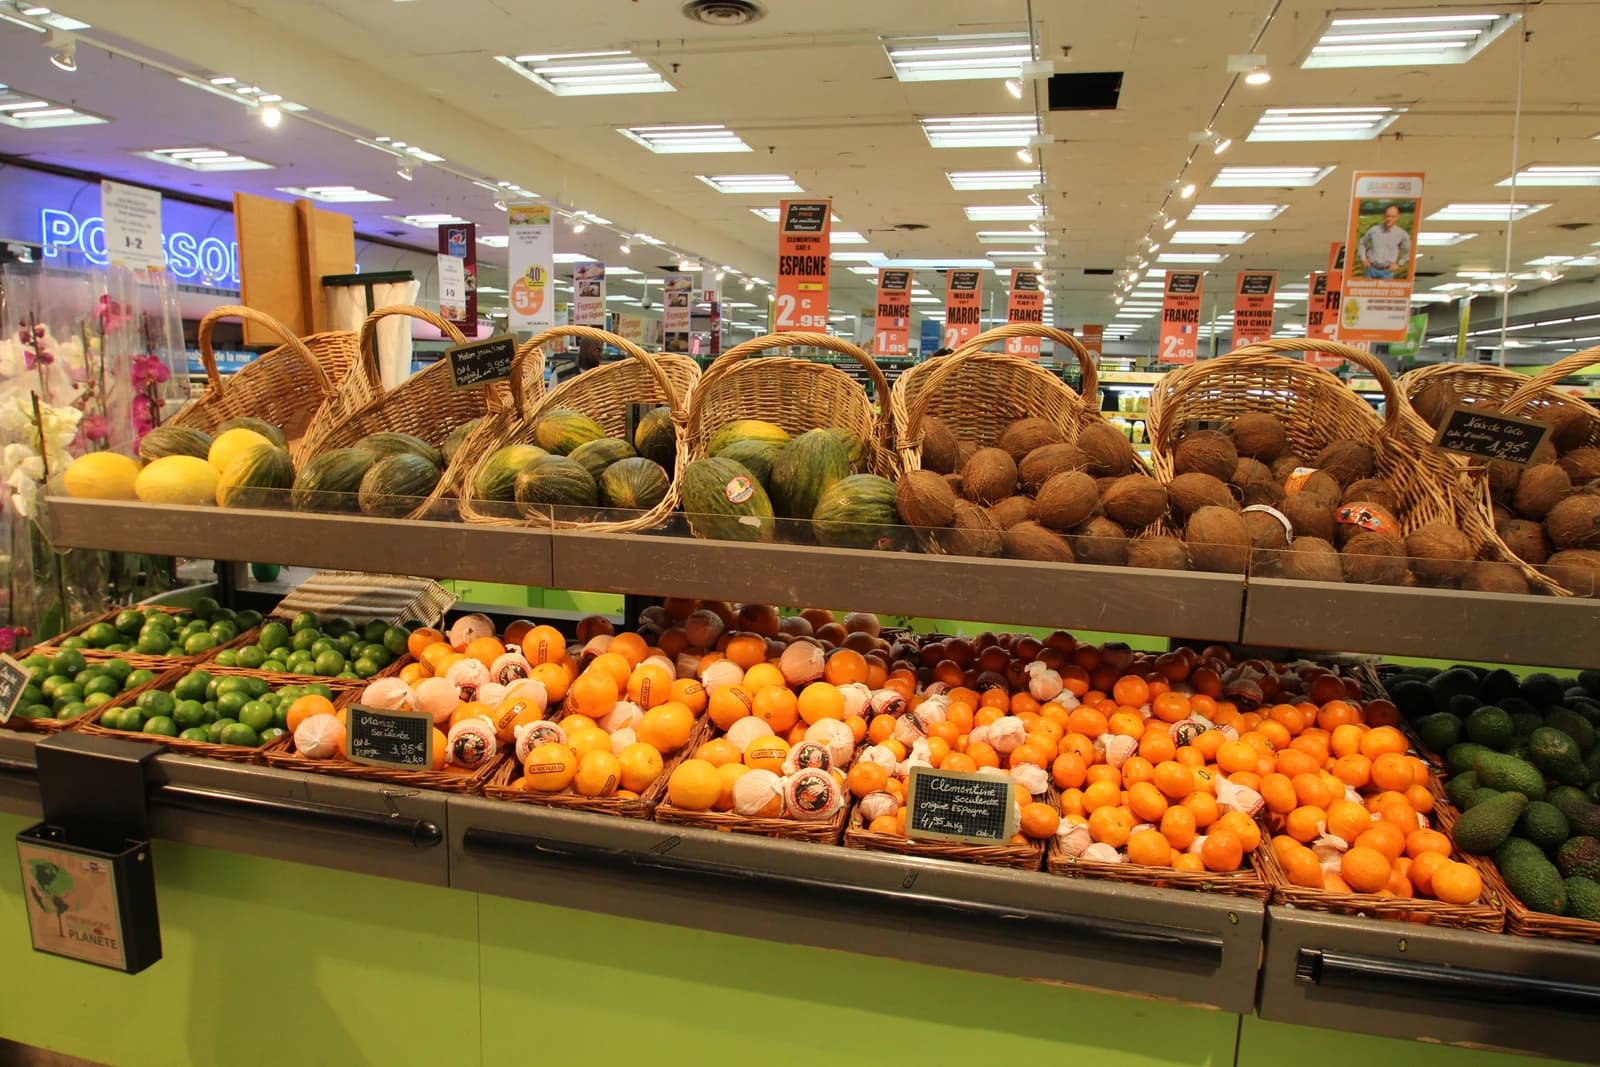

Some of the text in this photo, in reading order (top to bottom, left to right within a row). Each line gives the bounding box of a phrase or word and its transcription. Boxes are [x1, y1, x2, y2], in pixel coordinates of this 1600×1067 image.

[780, 255, 826, 276] ESPAGNE
[577, 302, 602, 312] Fromages
[776, 294, 796, 327] 2
[878, 304, 910, 317] FRANCE
[1009, 308, 1042, 321] FRANCE
[948, 307, 979, 324] MAROC
[1164, 308, 1199, 323] FRANCE
[930, 778, 996, 797] Clementine
